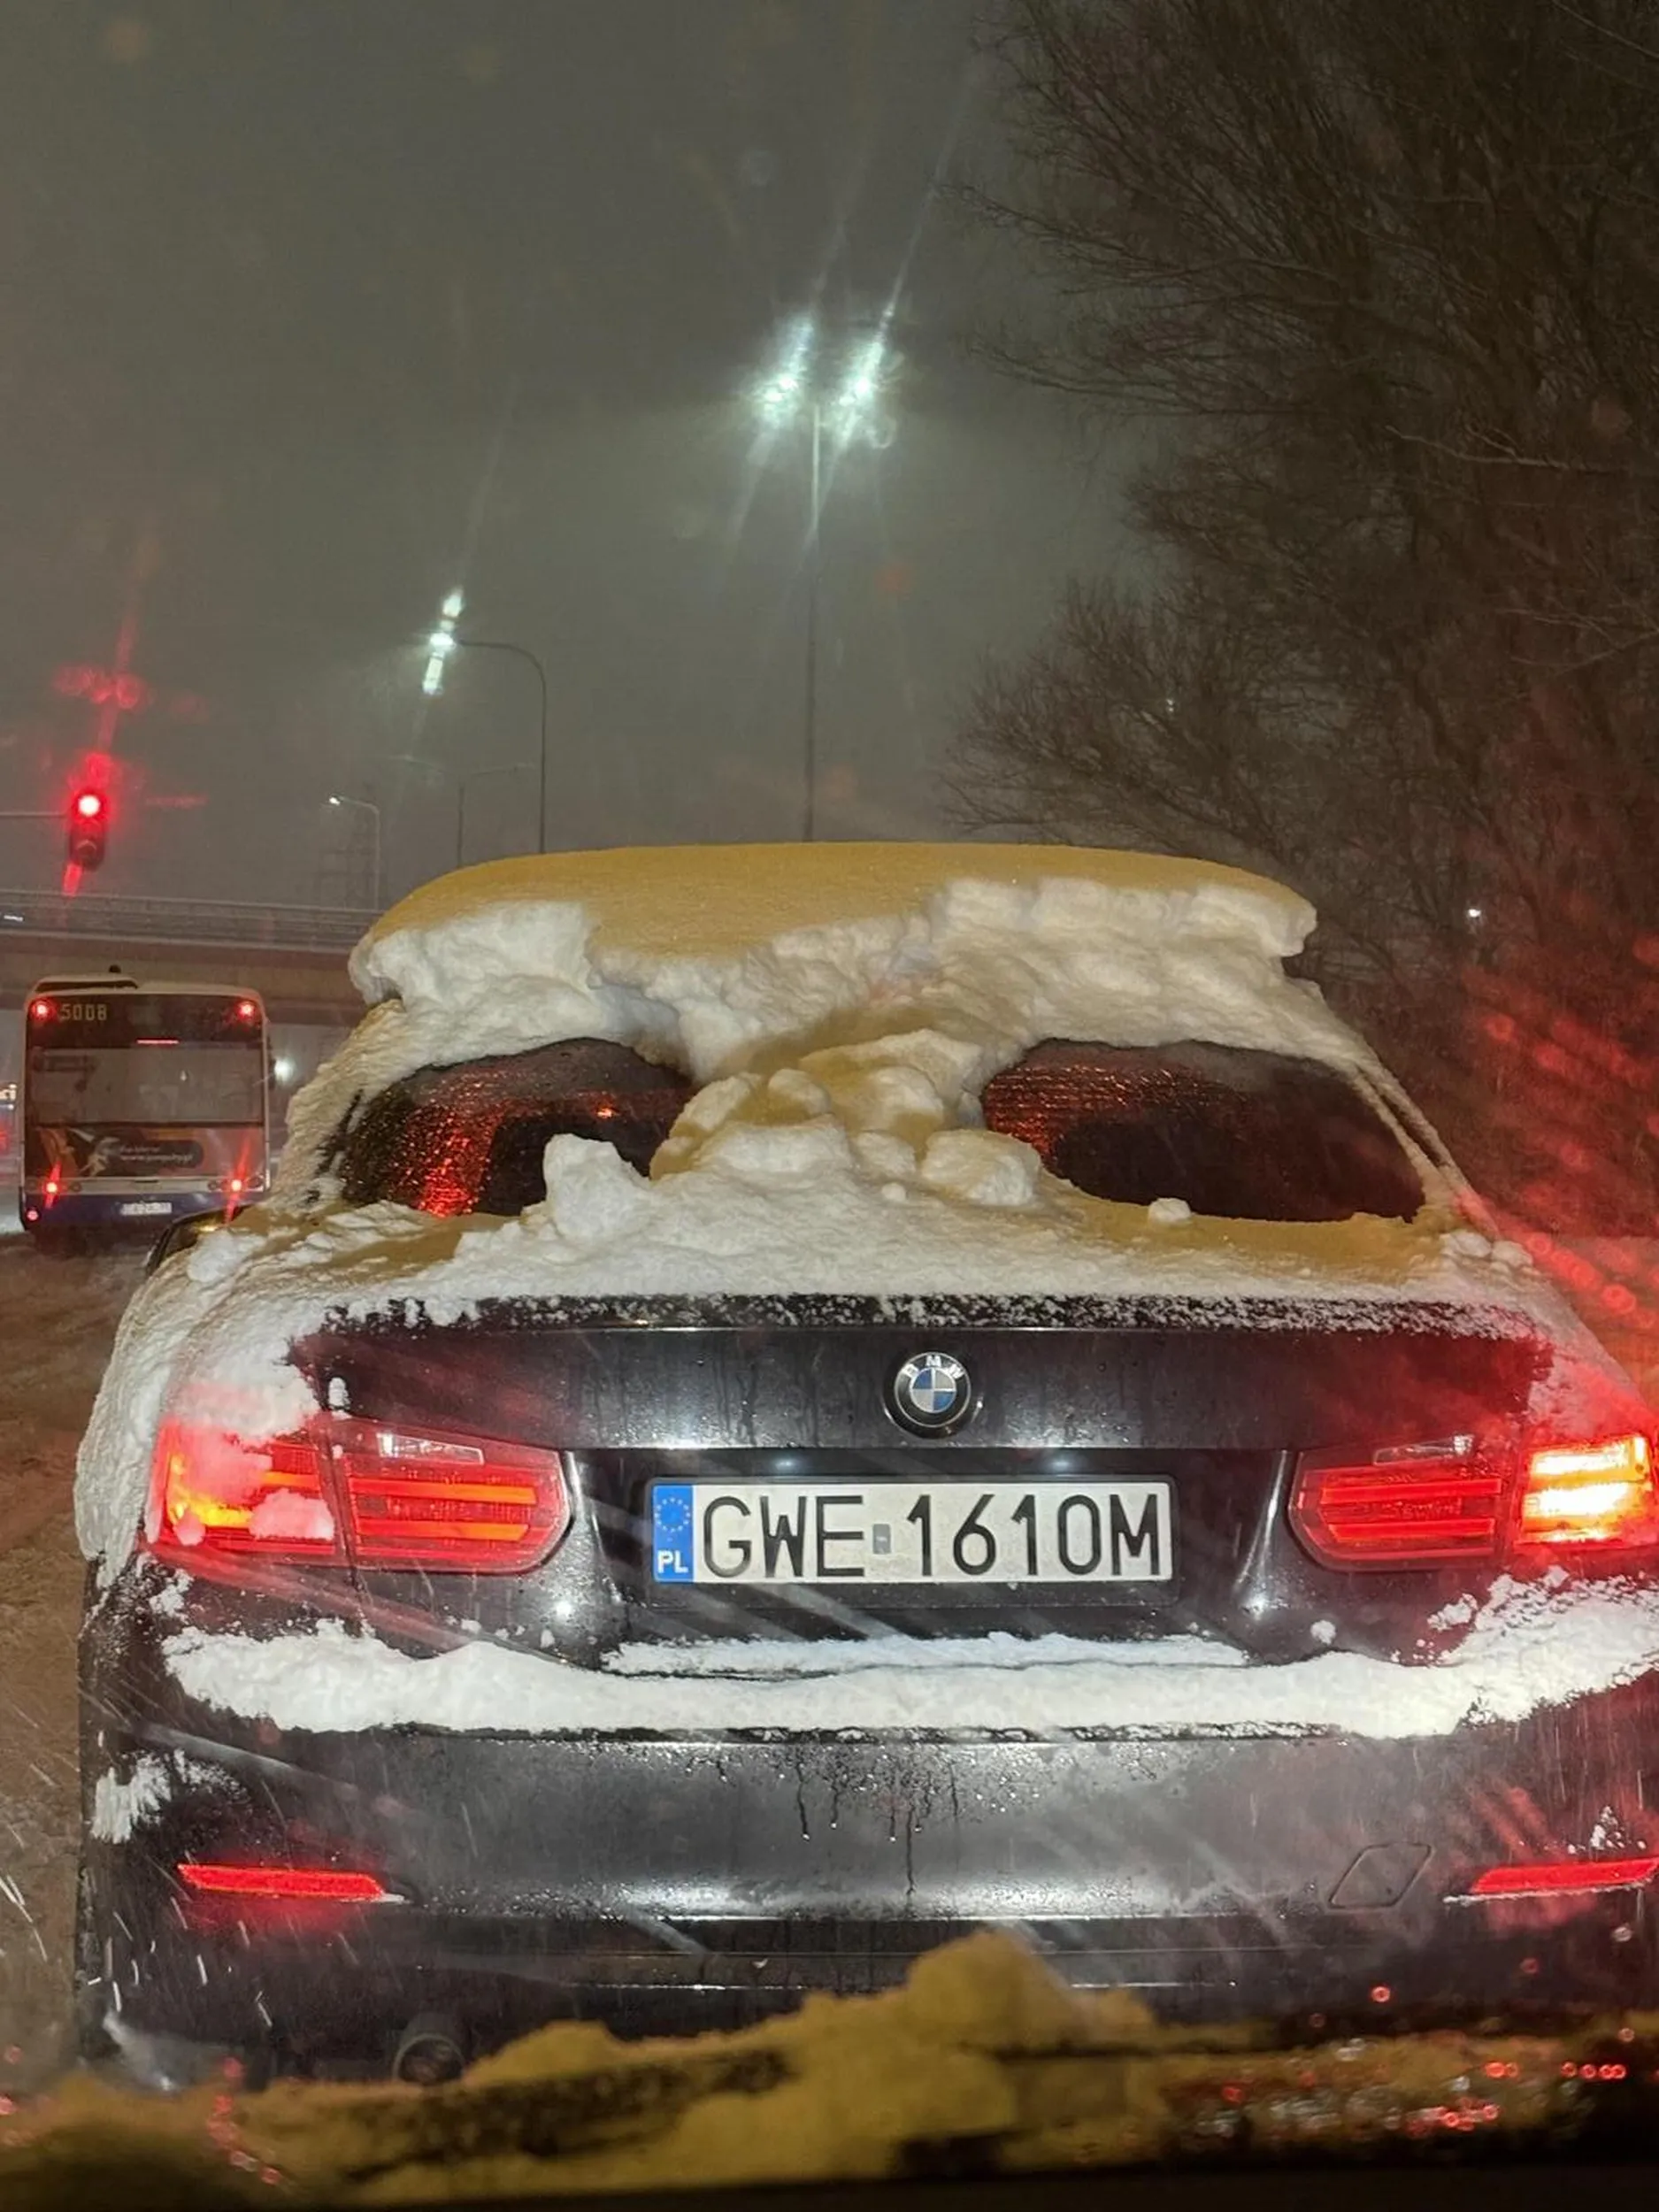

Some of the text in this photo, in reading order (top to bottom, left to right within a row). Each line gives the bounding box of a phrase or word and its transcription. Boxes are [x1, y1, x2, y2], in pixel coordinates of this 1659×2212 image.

[60, 1002, 107, 1021] 5008
[902, 1355, 965, 1379] BMW
[703, 1494, 1160, 1578] GWE 1610M
[657, 1549, 688, 1573] PL
